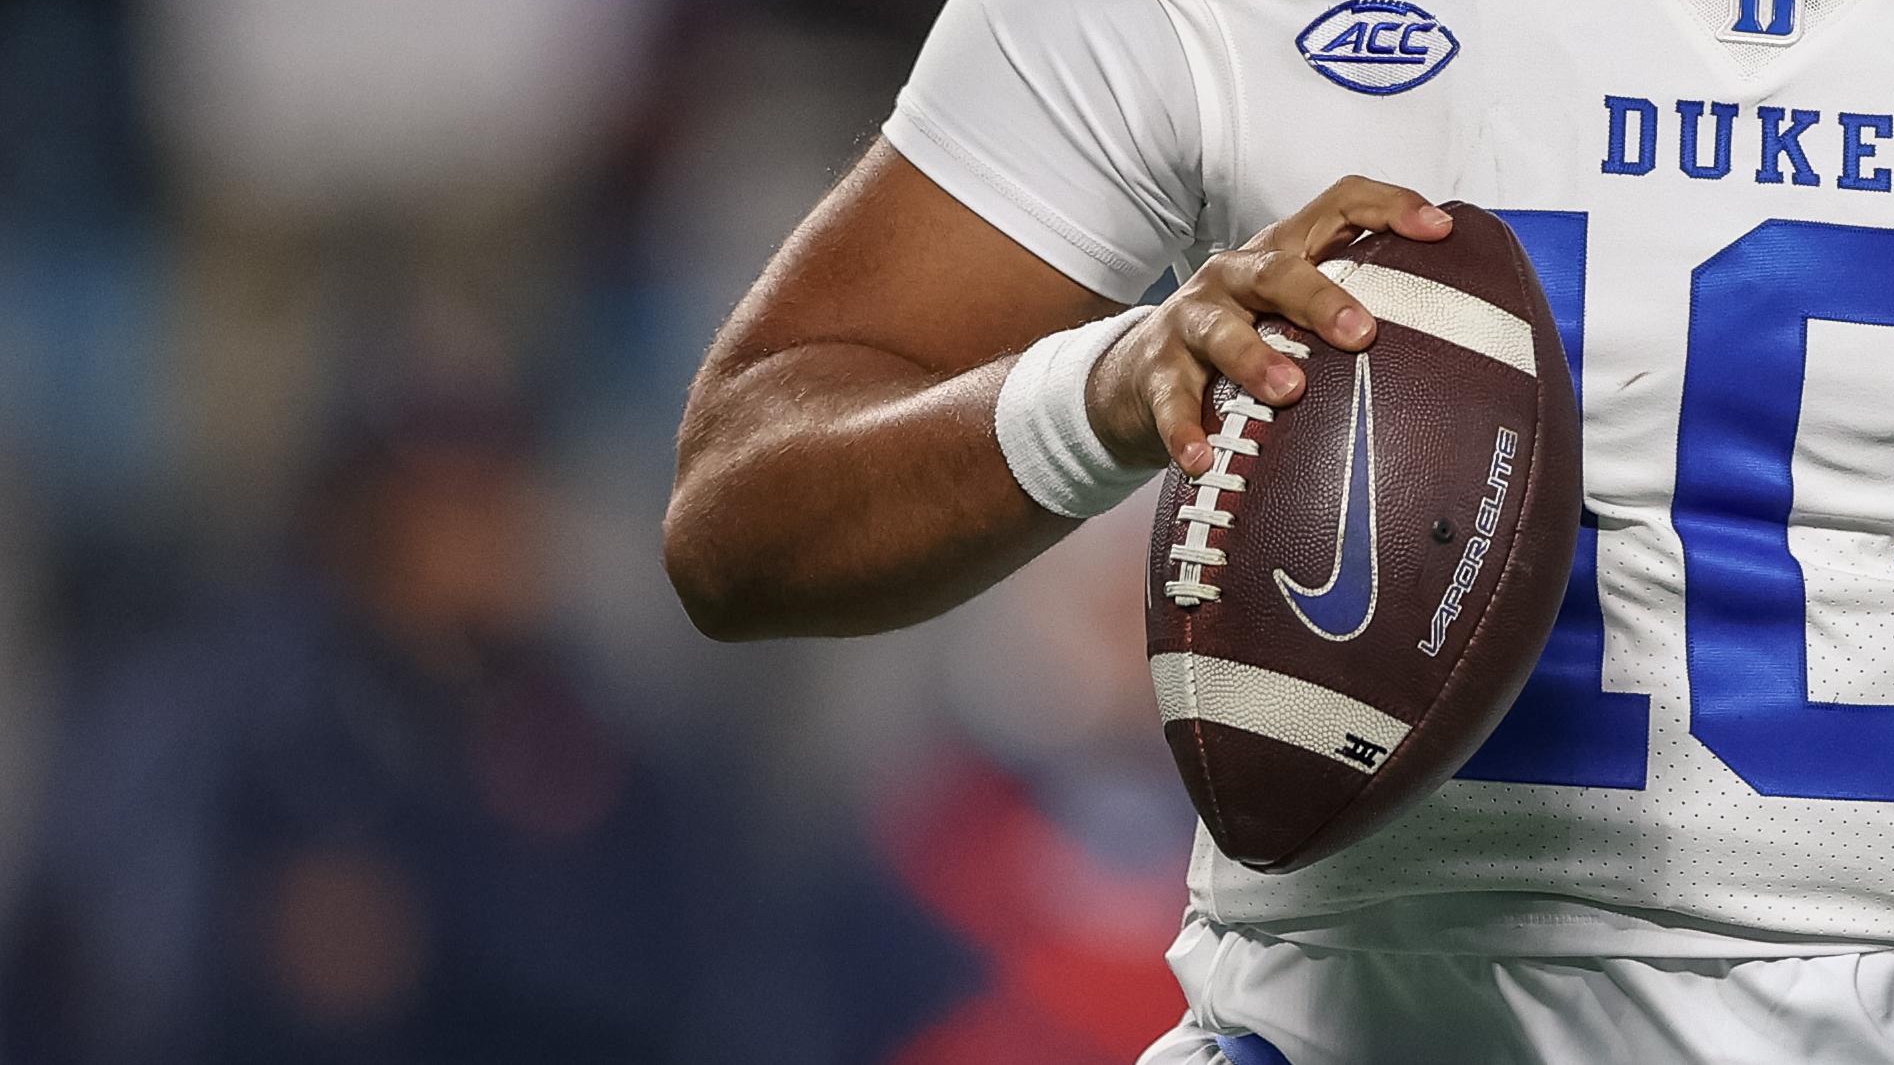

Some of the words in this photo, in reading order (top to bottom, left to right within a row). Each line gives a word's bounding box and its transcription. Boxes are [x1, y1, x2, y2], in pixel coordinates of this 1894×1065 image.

[1320, 21, 1438, 55] ACC
[1601, 94, 1894, 193] DUKE
[1417, 535, 1491, 658] VAPOR
[1475, 425, 1518, 538] ELITE
